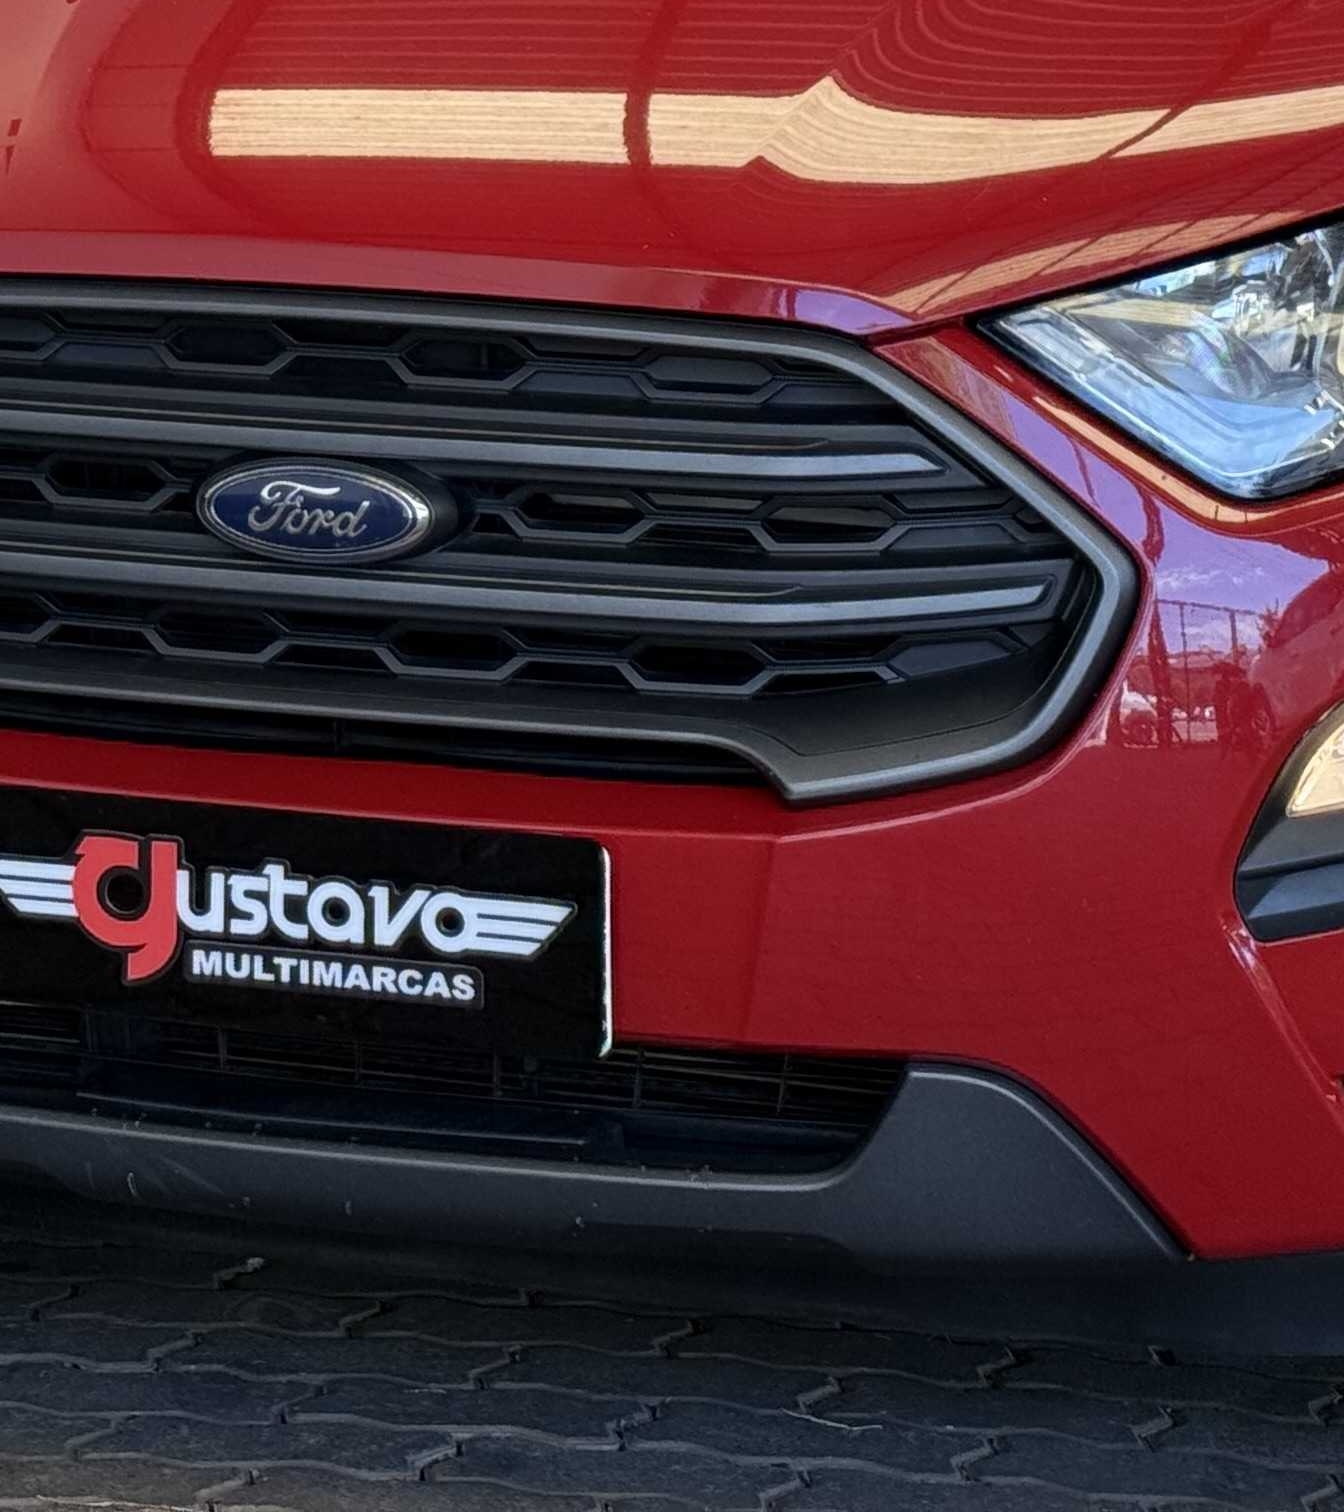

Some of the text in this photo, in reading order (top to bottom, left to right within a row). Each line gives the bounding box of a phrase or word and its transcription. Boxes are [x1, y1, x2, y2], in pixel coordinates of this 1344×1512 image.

[248, 480, 370, 537] Ford
[72, 835, 476, 980] gustavo
[192, 949, 476, 1000] MULTIMARCAS
